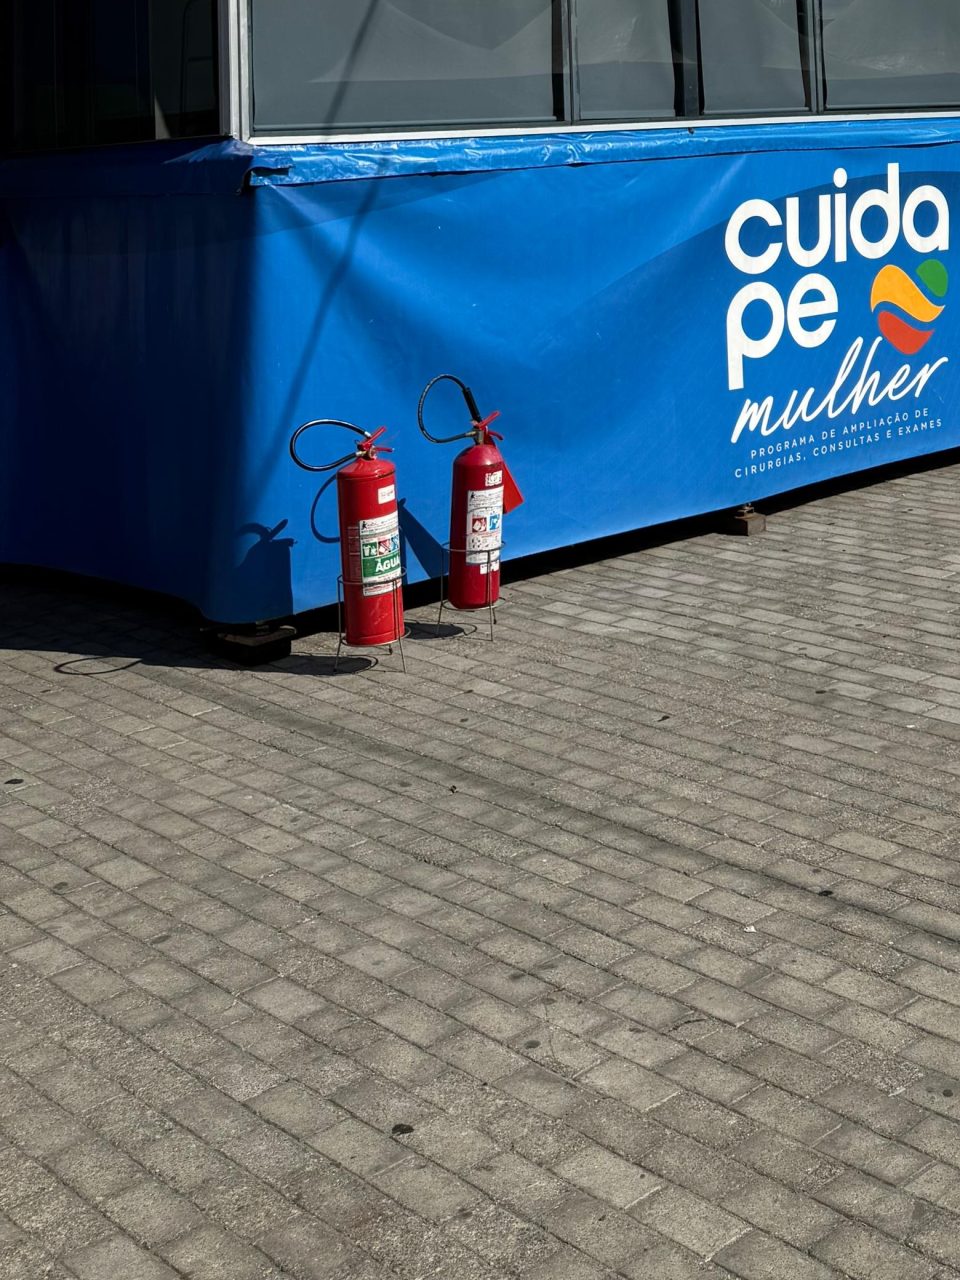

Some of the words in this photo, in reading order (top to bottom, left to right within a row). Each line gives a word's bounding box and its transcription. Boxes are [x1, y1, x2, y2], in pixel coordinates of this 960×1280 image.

[724, 162, 950, 275] cuida
[726, 273, 838, 391] pe
[730, 335, 949, 444] mulher
[750, 434, 815, 460] PROGRAMA
[821, 428, 836, 440] DE
[842, 412, 909, 435] AMPLIAÇÃO
[915, 407, 929, 418] DE
[734, 452, 807, 478] CIRURGIAS,
[813, 432, 880, 457] CONSULTAS
[886, 429, 892, 438] E
[898, 418, 943, 436] EXAMES
